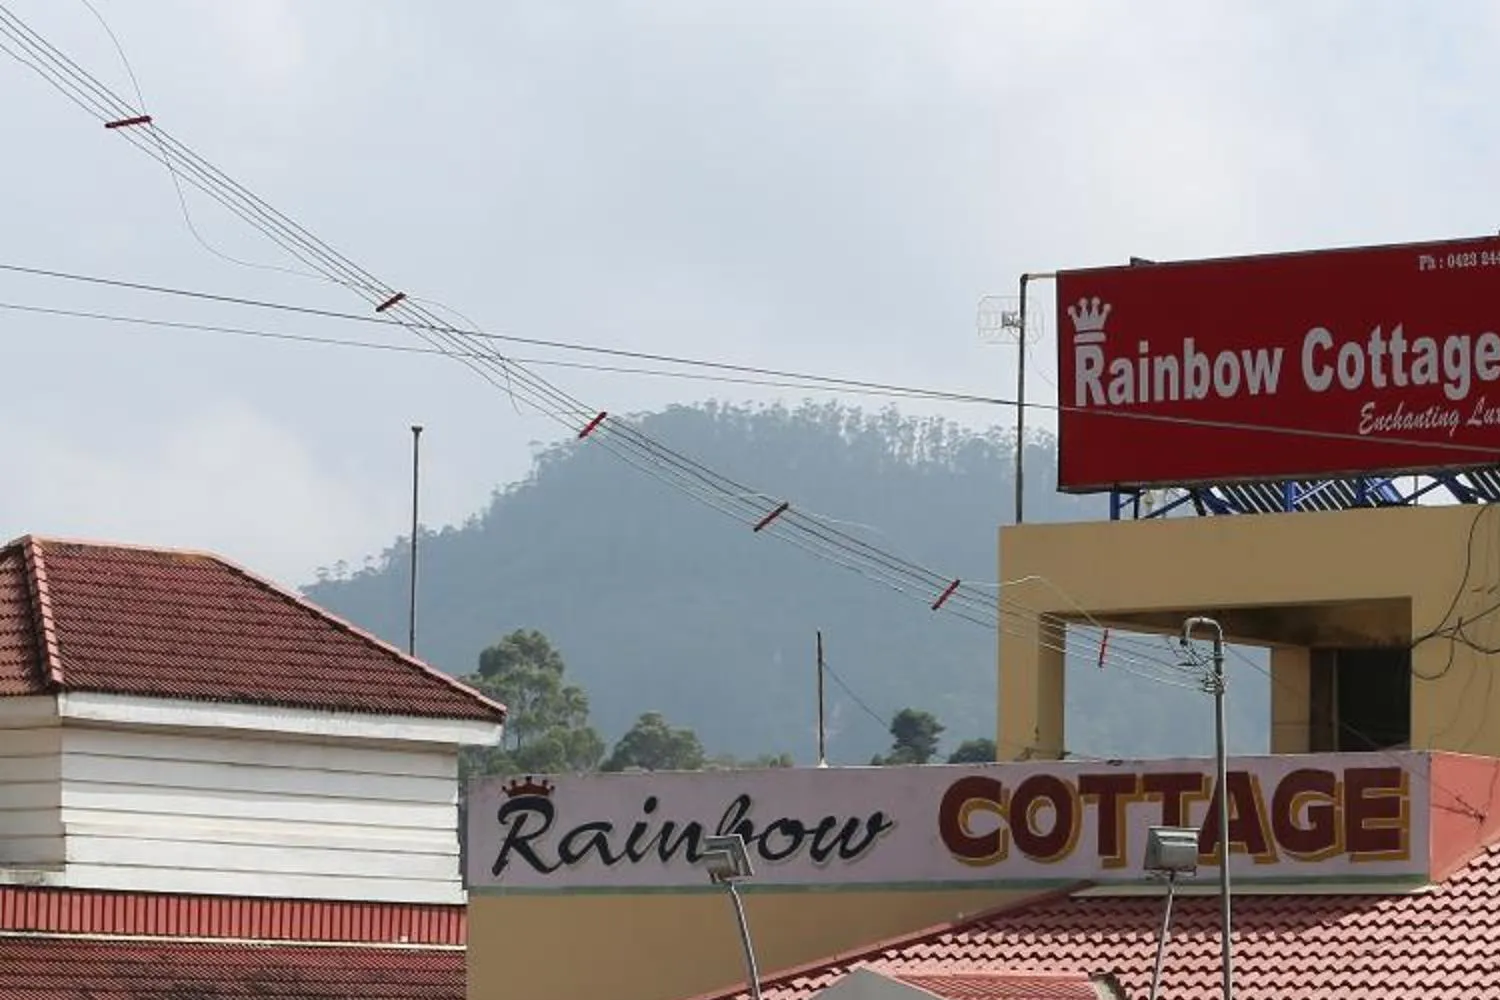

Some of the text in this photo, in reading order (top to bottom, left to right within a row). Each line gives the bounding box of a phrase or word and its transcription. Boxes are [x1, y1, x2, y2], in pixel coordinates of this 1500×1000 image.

[1419, 255, 1436, 271] Ph
[1447, 252, 1477, 269] 0423
[1075, 337, 1284, 407] Rainbow
[1359, 400, 1461, 437] Enchanting
[492, 767, 1410, 877] Rainbow COTTAGE
